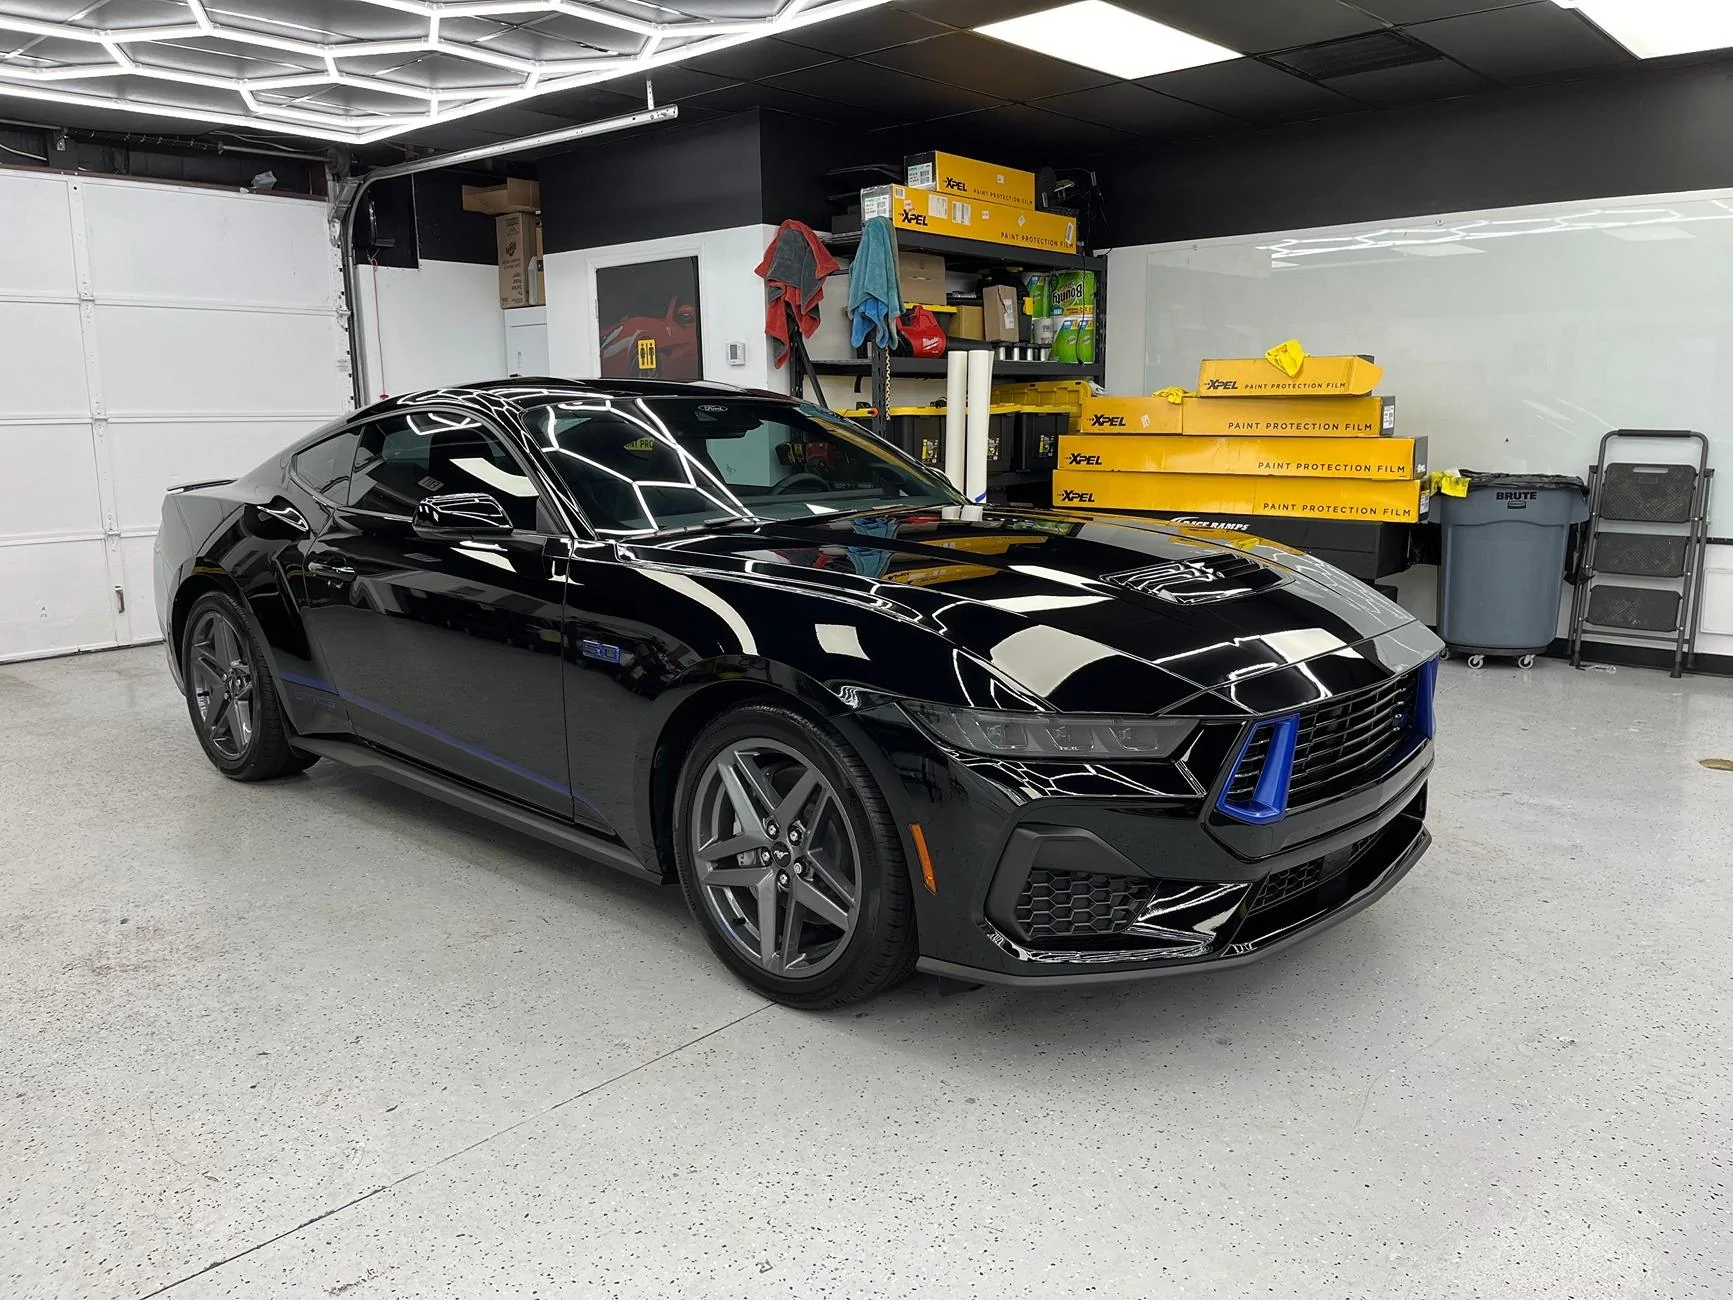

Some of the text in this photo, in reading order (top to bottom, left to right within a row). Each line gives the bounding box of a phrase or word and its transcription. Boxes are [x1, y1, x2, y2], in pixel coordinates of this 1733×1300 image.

[944, 176, 968, 192] XPEL
[973, 188, 988, 196] PAINT
[989, 192, 1020, 203] PROTECTION
[902, 208, 929, 227] XPEL
[1000, 231, 1019, 240] PAINT
[1021, 234, 1058, 247] PROTECTION
[1052, 283, 1083, 305] Bounty
[1206, 379, 1239, 390] XPEL
[1270, 382, 1323, 390] PROTECTION
[1090, 413, 1126, 427] XPEL
[1228, 422, 1372, 431] PAINT PROTECTION FILM
[1068, 452, 1103, 466] XPEL
[1258, 462, 1406, 473] PAINT PROTECTION FILM
[1060, 489, 1095, 503] XPEL
[1496, 491, 1537, 500] BRUTE
[1263, 503, 1412, 517] PAINT PROTECTION FILM
[1210, 521, 1251, 531] RAMPS
